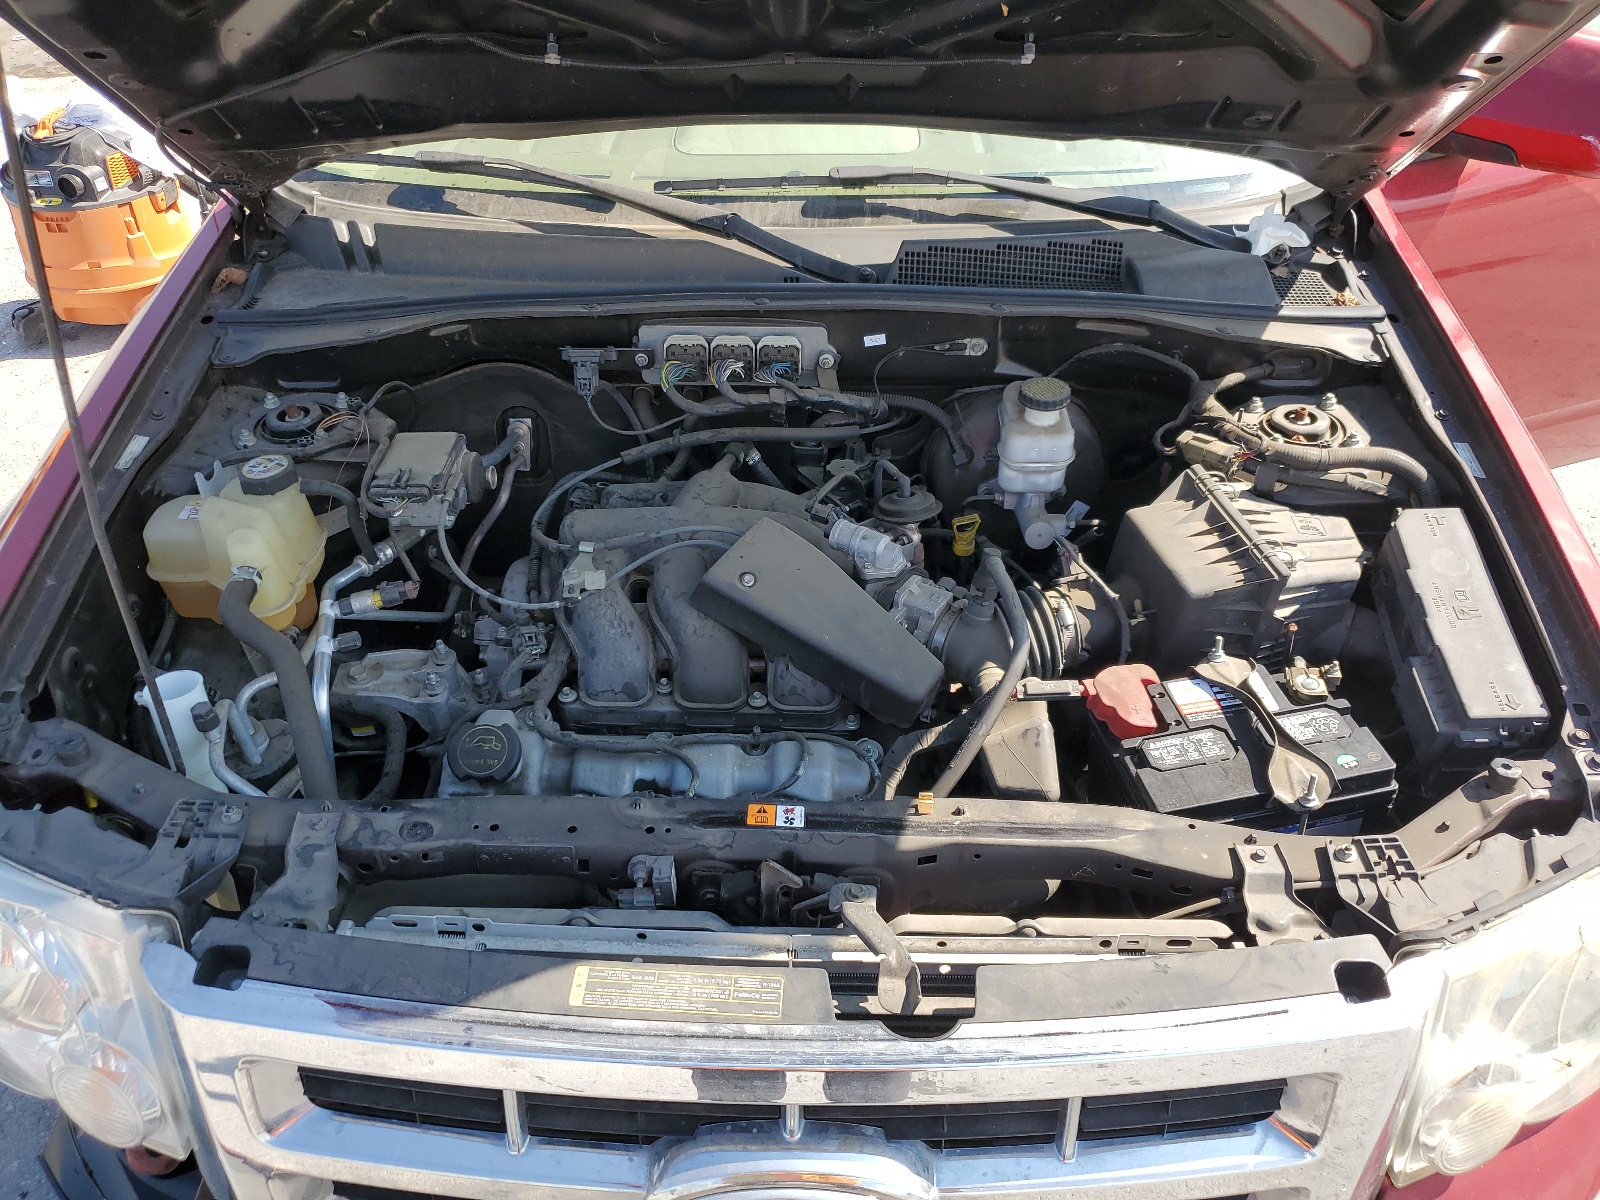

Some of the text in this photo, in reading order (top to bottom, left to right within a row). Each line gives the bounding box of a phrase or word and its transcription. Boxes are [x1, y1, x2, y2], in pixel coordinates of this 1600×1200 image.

[1423, 512, 1438, 537] RELEASE
[1431, 581, 1457, 629] COMPARTMENT
[1432, 596, 1442, 613] FUSE
[1488, 680, 1506, 712] RELEASE
